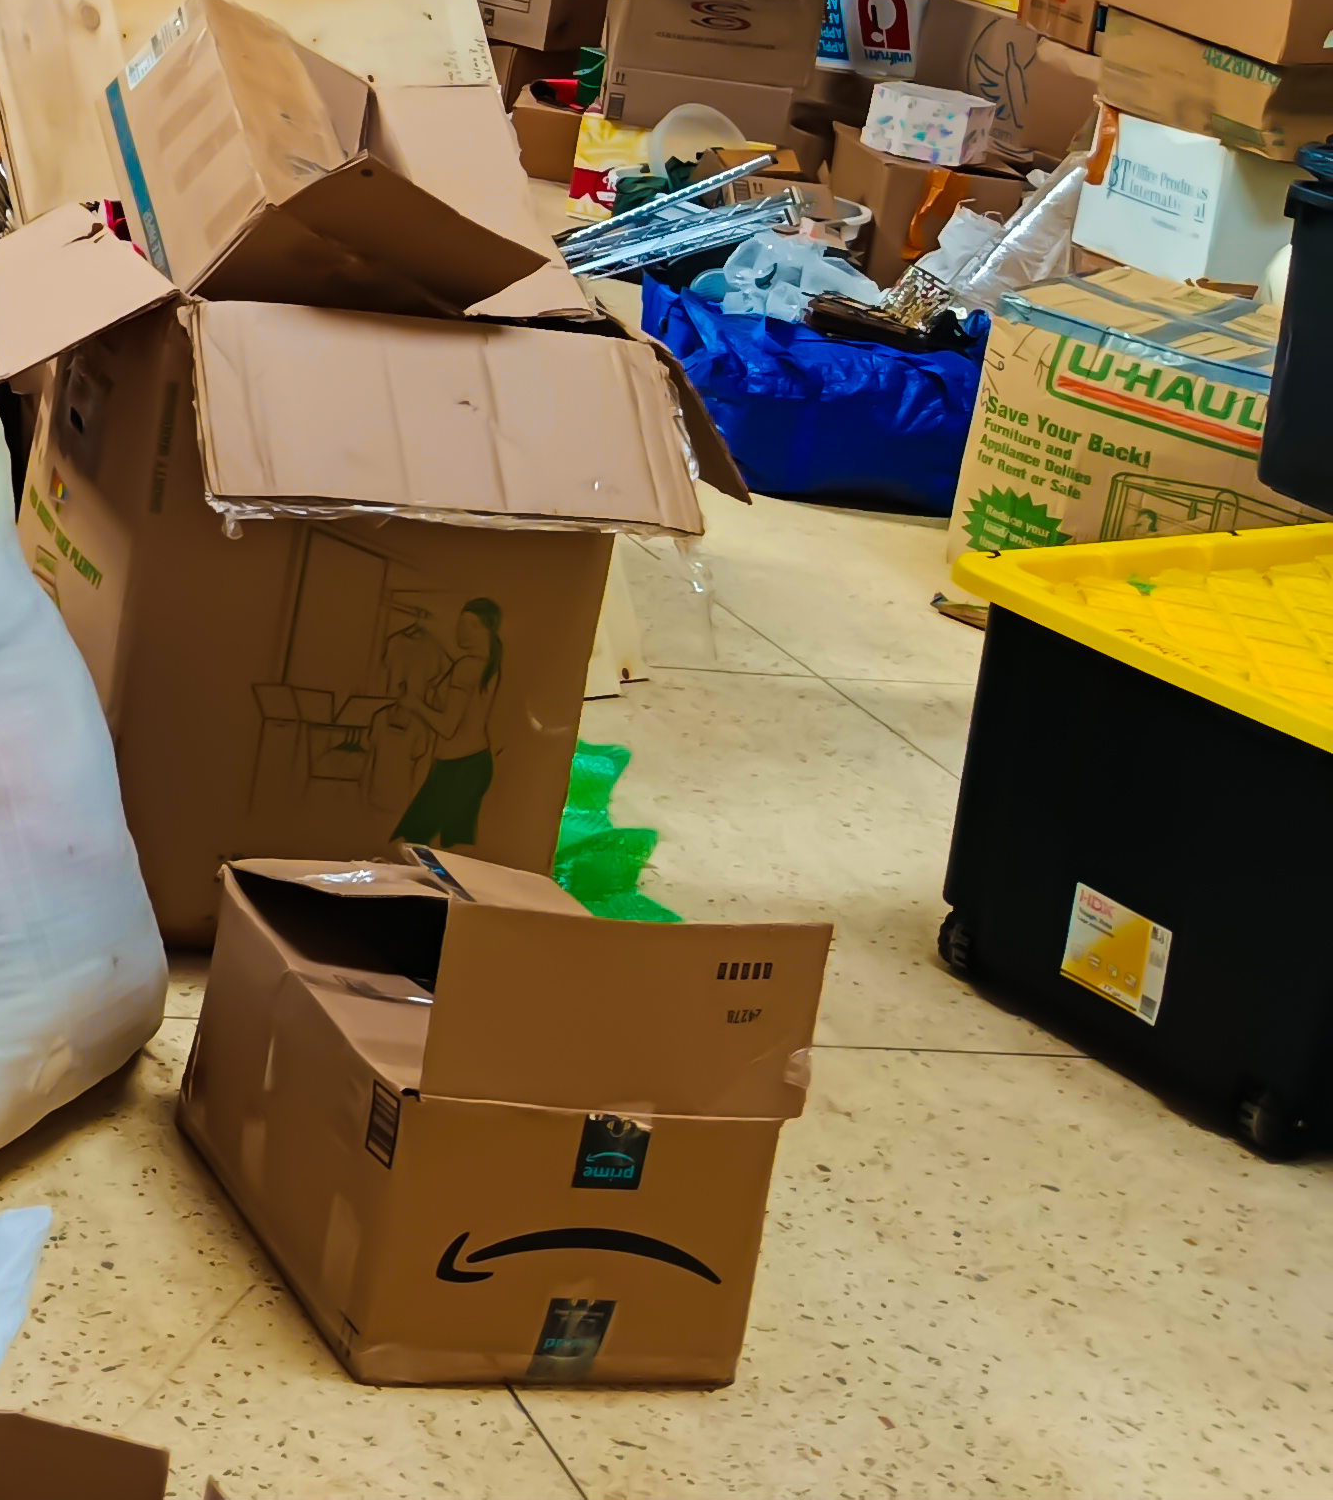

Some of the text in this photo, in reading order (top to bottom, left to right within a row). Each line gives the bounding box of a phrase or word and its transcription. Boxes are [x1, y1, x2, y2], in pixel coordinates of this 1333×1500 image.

[1160, 171, 1209, 201] Produs
[1067, 343, 1267, 432] U-HAUL
[983, 416, 1073, 461] Furniture and
[987, 394, 1152, 469] Save Your Back!
[976, 449, 1082, 500] for Rent or Sale
[979, 432, 1093, 486] Appliance Dollies
[985, 504, 1052, 539] Reduce your
[1078, 888, 1116, 919] HDX
[582, 1164, 635, 1182] prime
